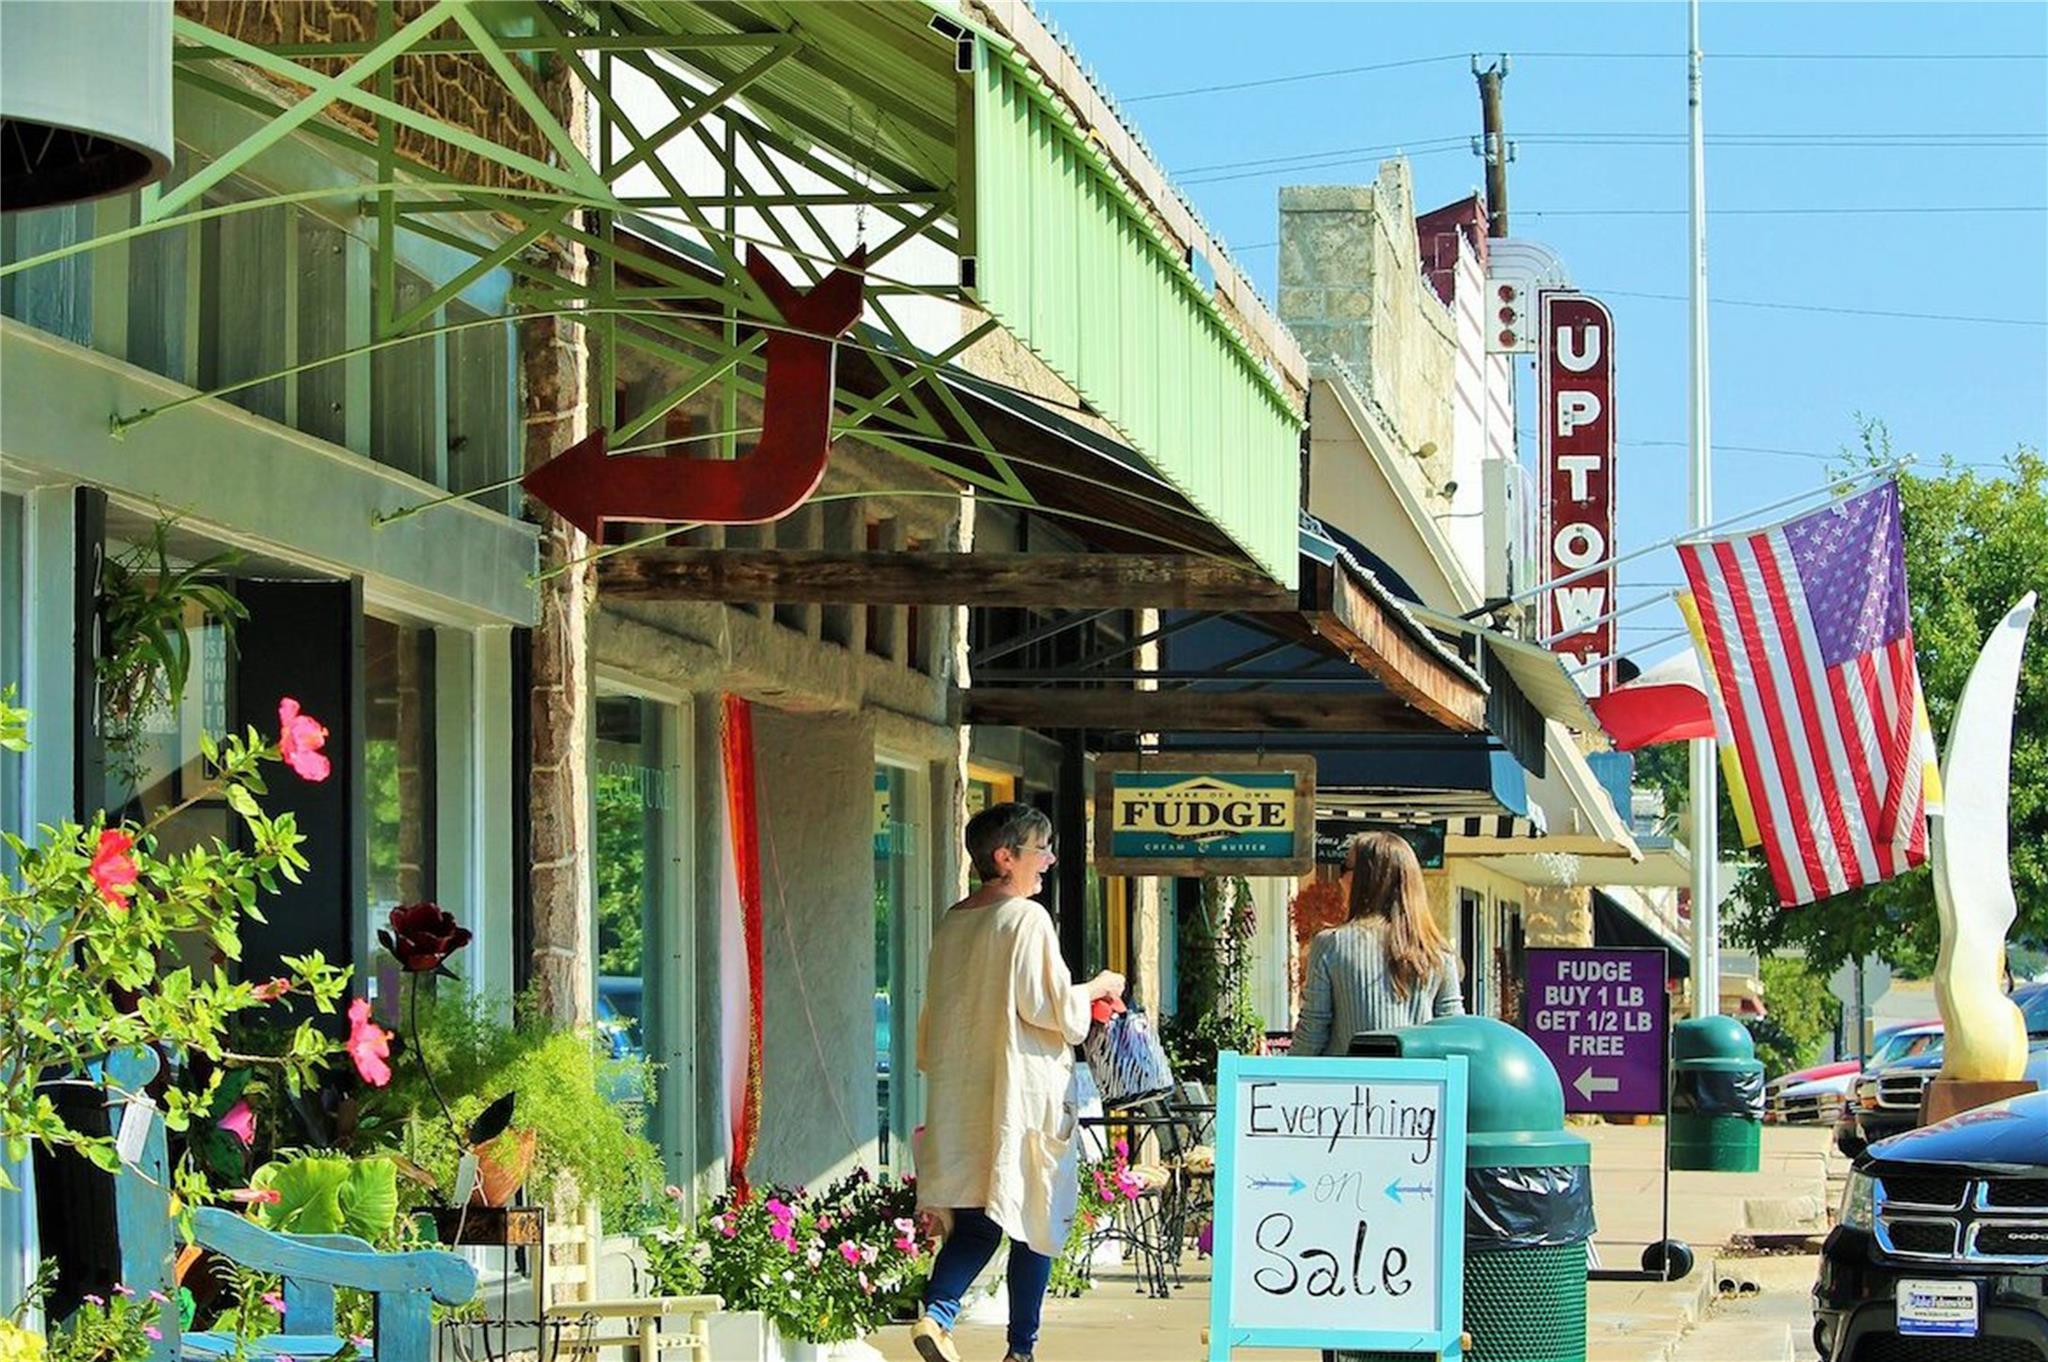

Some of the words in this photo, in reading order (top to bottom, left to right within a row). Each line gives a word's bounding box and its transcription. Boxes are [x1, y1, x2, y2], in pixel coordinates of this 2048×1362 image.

[1121, 800, 1286, 827] FUDGE
[1144, 843, 1185, 851] CREAM
[1221, 844, 1267, 852] BUTTER
[1557, 961, 1632, 982] FUDGE
[1545, 986, 1590, 1006] BUY
[1597, 986, 1608, 1007] 1
[1616, 987, 1645, 1007] LB
[1535, 1010, 1580, 1031] GET
[1587, 1010, 1618, 1032] 1/2
[1624, 1011, 1653, 1032] LB
[1568, 1035, 1624, 1056] FREE
[1250, 1082, 1436, 1165] Everything
[1313, 1170, 1366, 1213] on
[1253, 1212, 1412, 1298] Sale
